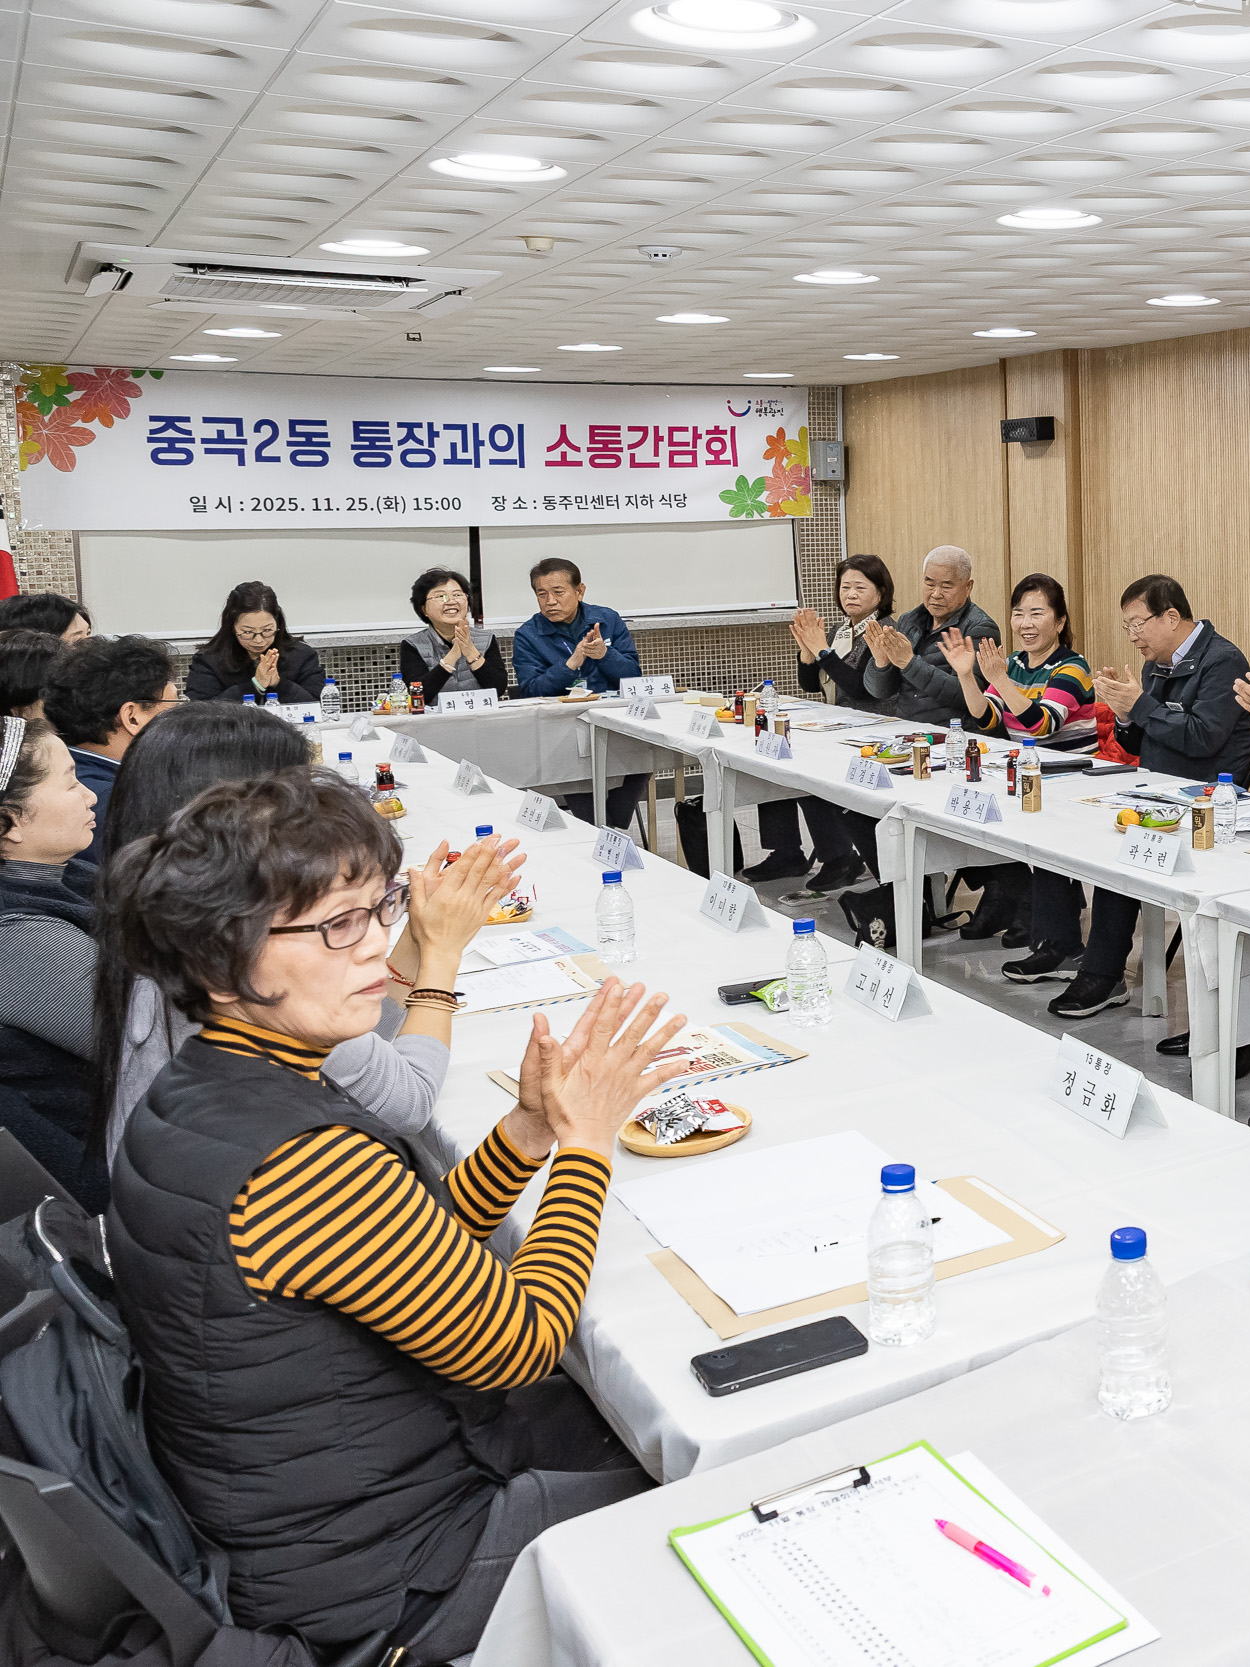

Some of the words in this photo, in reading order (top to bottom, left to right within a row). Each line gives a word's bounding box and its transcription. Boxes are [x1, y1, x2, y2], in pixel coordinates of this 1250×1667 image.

[147, 415, 331, 467] 중곡2동
[350, 421, 525, 468] 통장과의
[545, 424, 738, 468] 소통간담회
[251, 497, 305, 512] 2025.
[312, 497, 340, 512] 11.
[346, 496, 406, 514] 25.(화)
[413, 496, 461, 511] 15:00
[542, 494, 620, 510] 동주민센터
[625, 493, 654, 509] 지하
[659, 493, 687, 508] 식당
